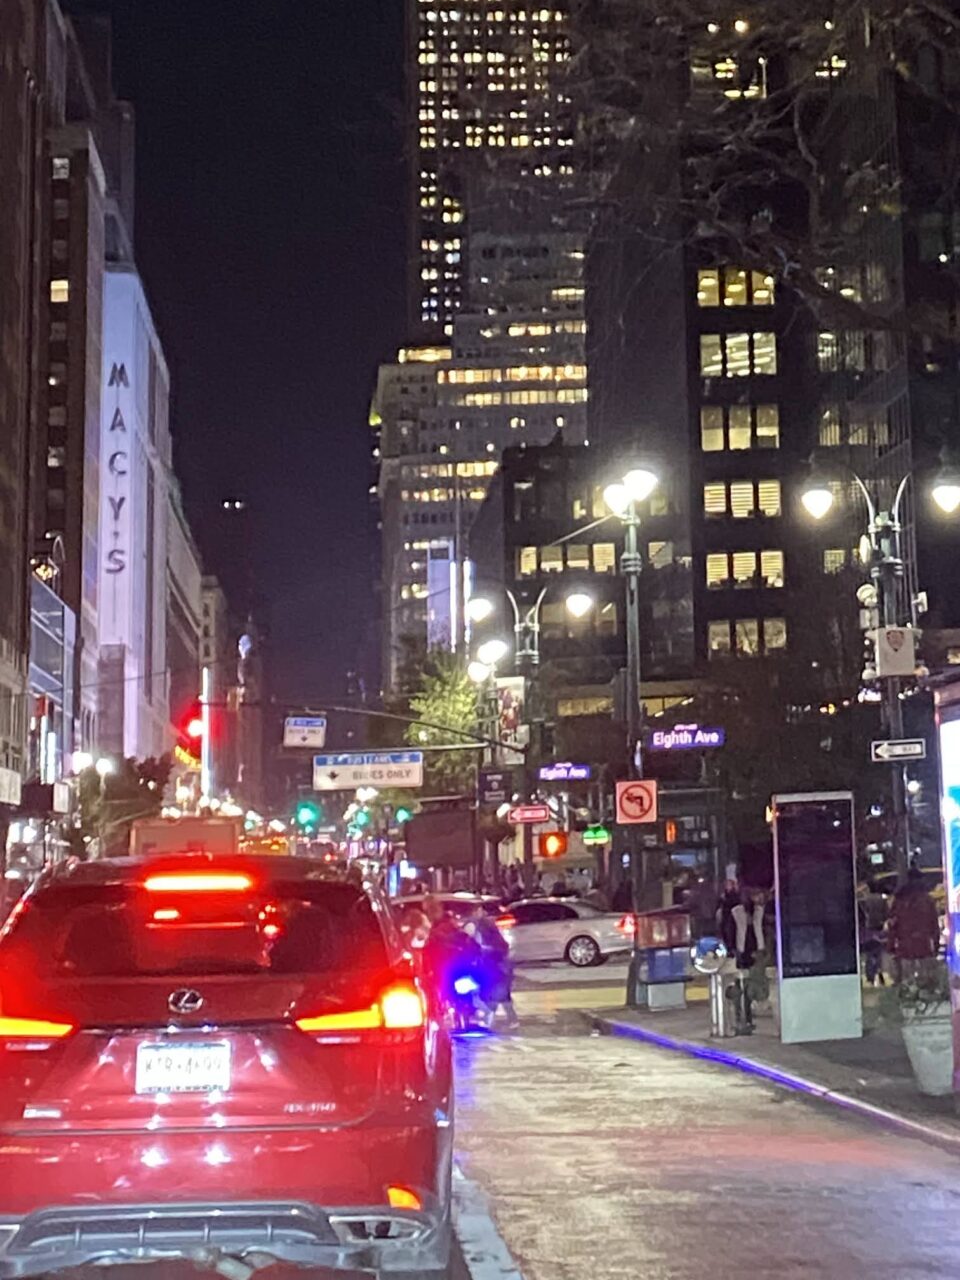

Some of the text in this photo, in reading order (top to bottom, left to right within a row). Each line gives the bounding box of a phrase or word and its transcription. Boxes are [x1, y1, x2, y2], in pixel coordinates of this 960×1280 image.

[107, 361, 130, 575] MACY'S
[653, 730, 719, 749] Eighth Ave
[386, 768, 411, 780] ONLY
[540, 767, 587, 781] Eighth Ave
